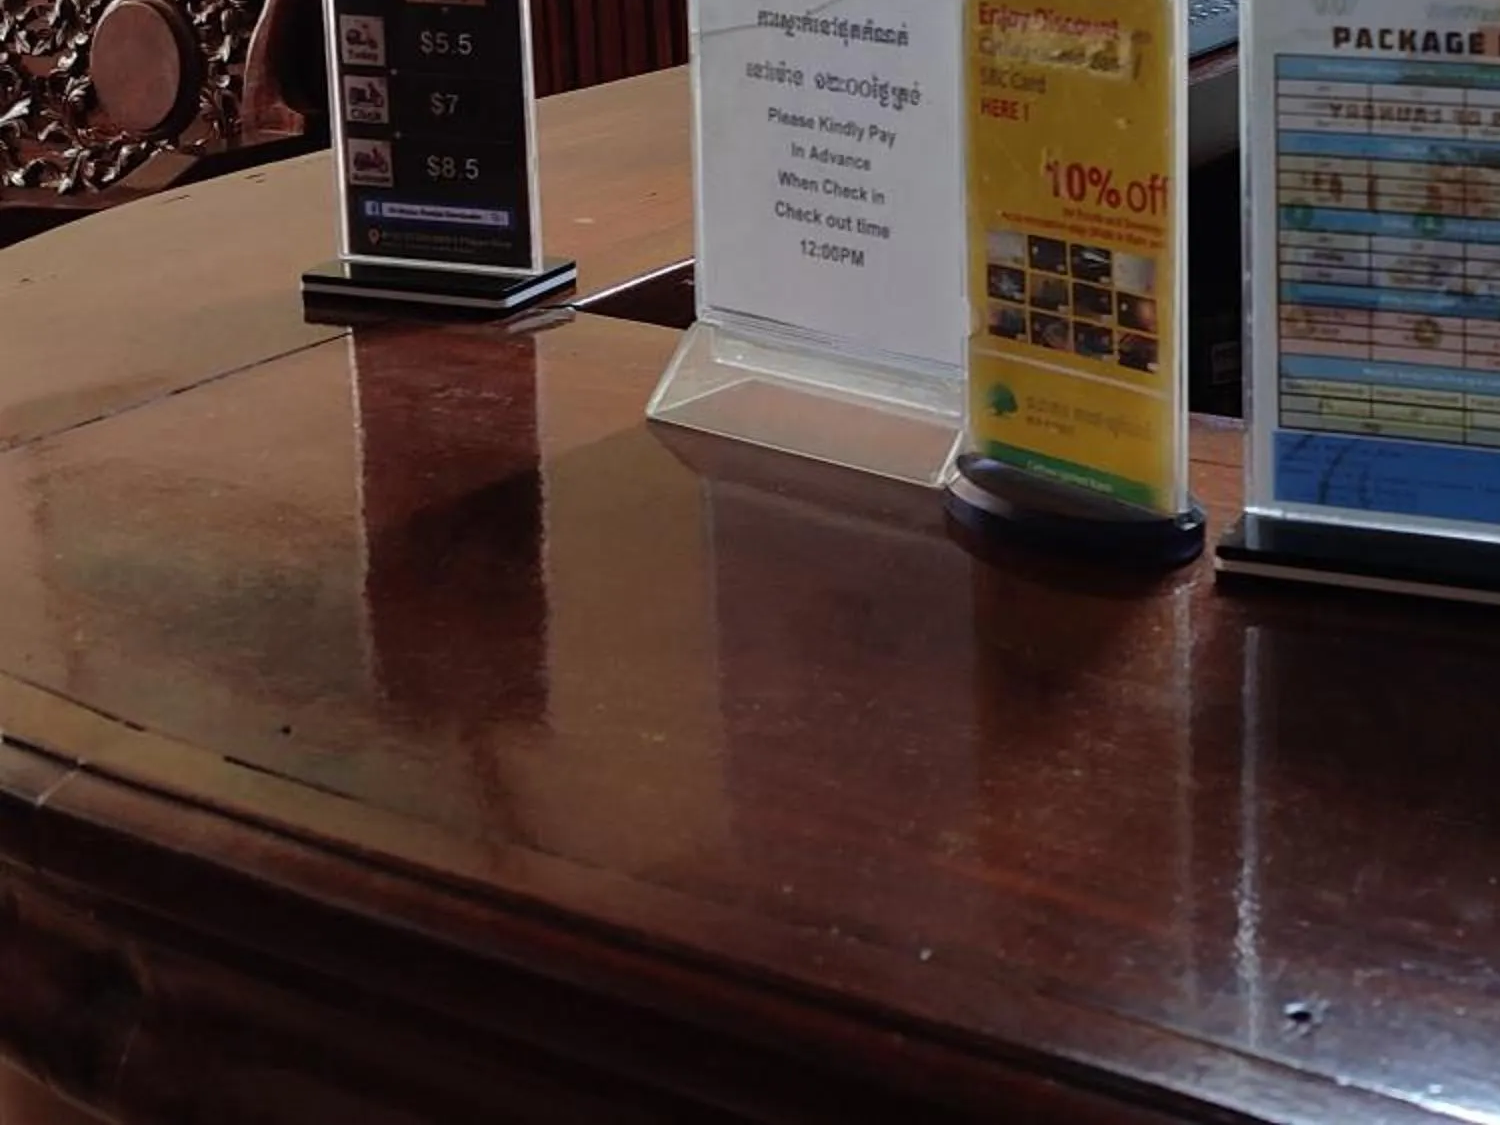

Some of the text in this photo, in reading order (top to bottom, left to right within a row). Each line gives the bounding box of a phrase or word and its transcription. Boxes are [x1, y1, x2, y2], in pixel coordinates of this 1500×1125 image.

[420, 30, 473, 56] $5.5
[1332, 25, 1486, 56] PACKAGE
[430, 91, 459, 116] $7
[767, 106, 897, 149] Please Kindly Pay
[426, 154, 480, 180] $8.5
[791, 142, 872, 171] In Advance
[777, 169, 885, 205] When Check in
[1044, 160, 1121, 210] 10%
[774, 200, 891, 239] Check out time
[800, 239, 865, 268] 12:00PM
